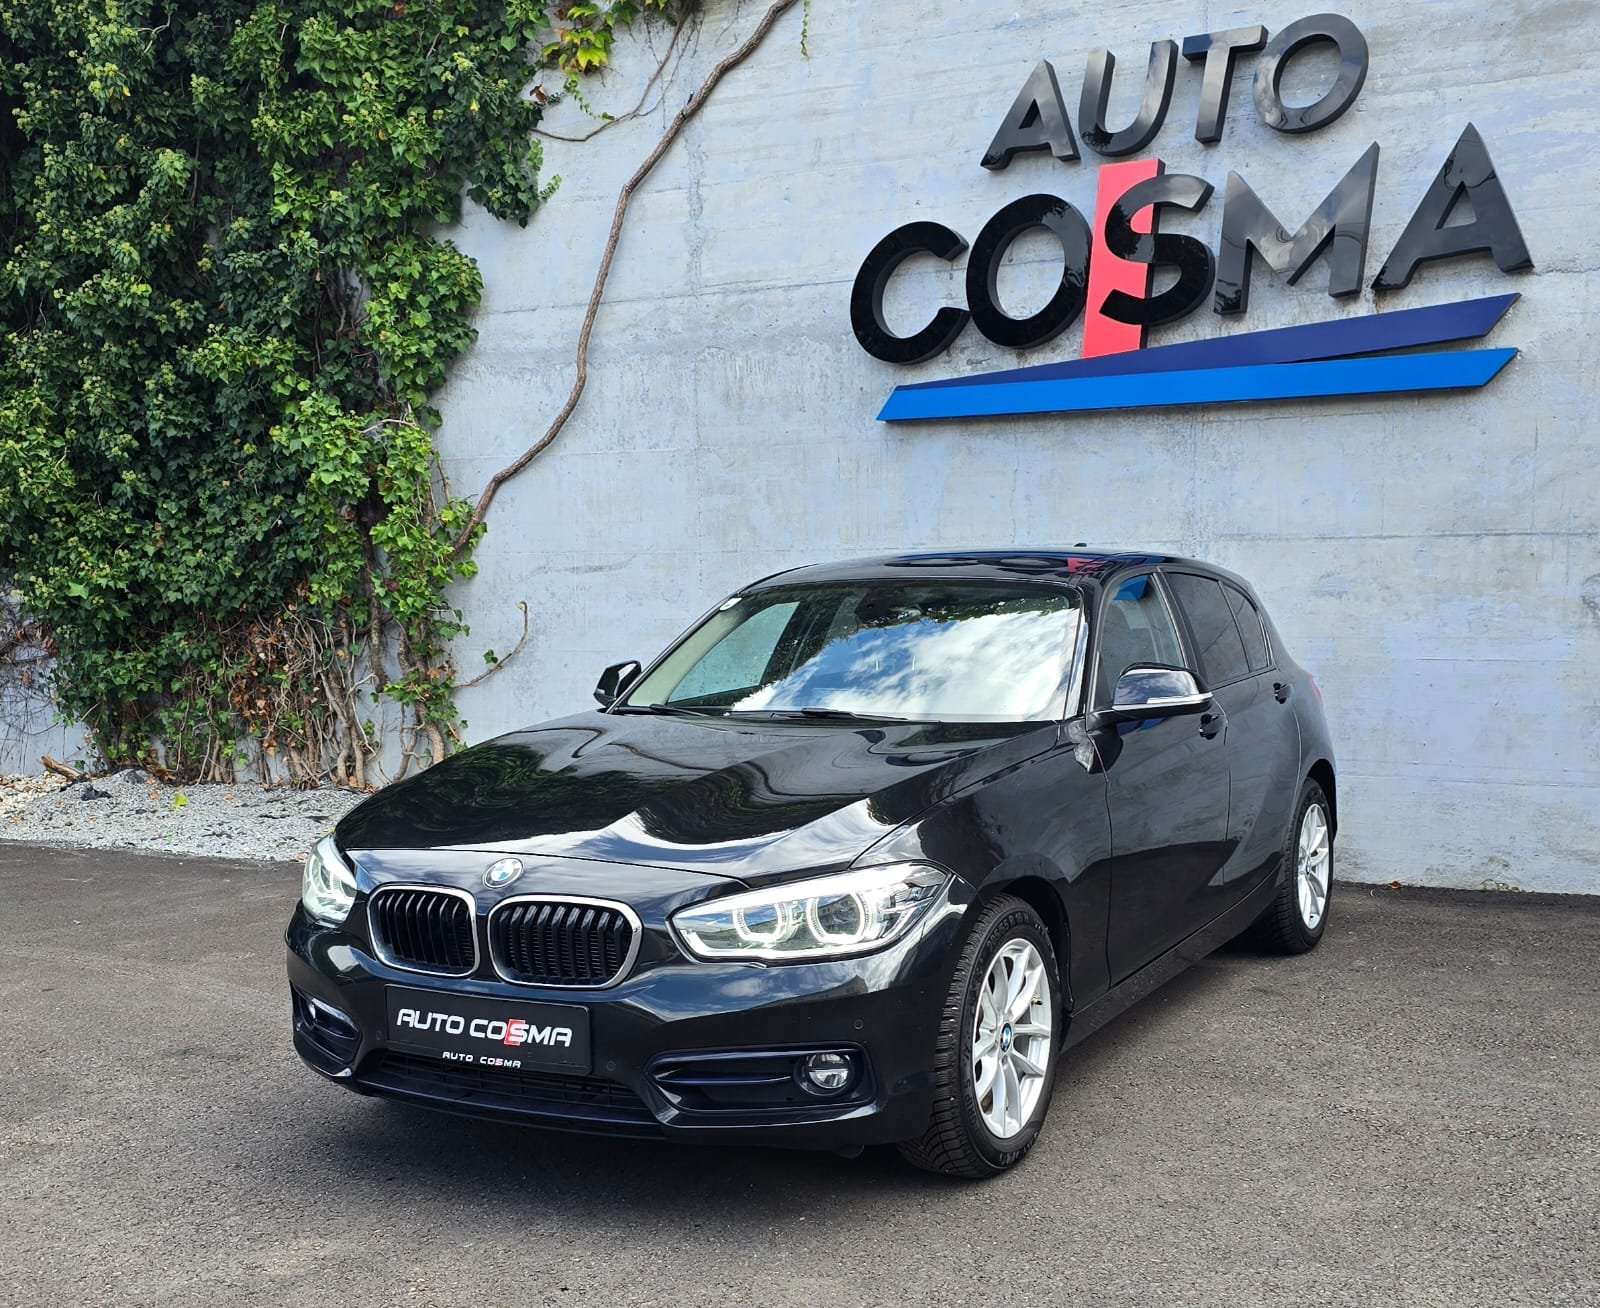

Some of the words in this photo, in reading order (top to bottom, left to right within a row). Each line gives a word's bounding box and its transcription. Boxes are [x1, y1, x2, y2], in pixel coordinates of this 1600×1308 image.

[980, 13, 1369, 170] AUTO
[850, 122, 1534, 365] COSMA
[396, 1008, 465, 1035] AUTO
[469, 1018, 573, 1047] COSMA
[442, 1051, 474, 1062] AUTO
[479, 1056, 522, 1069] COSMA
